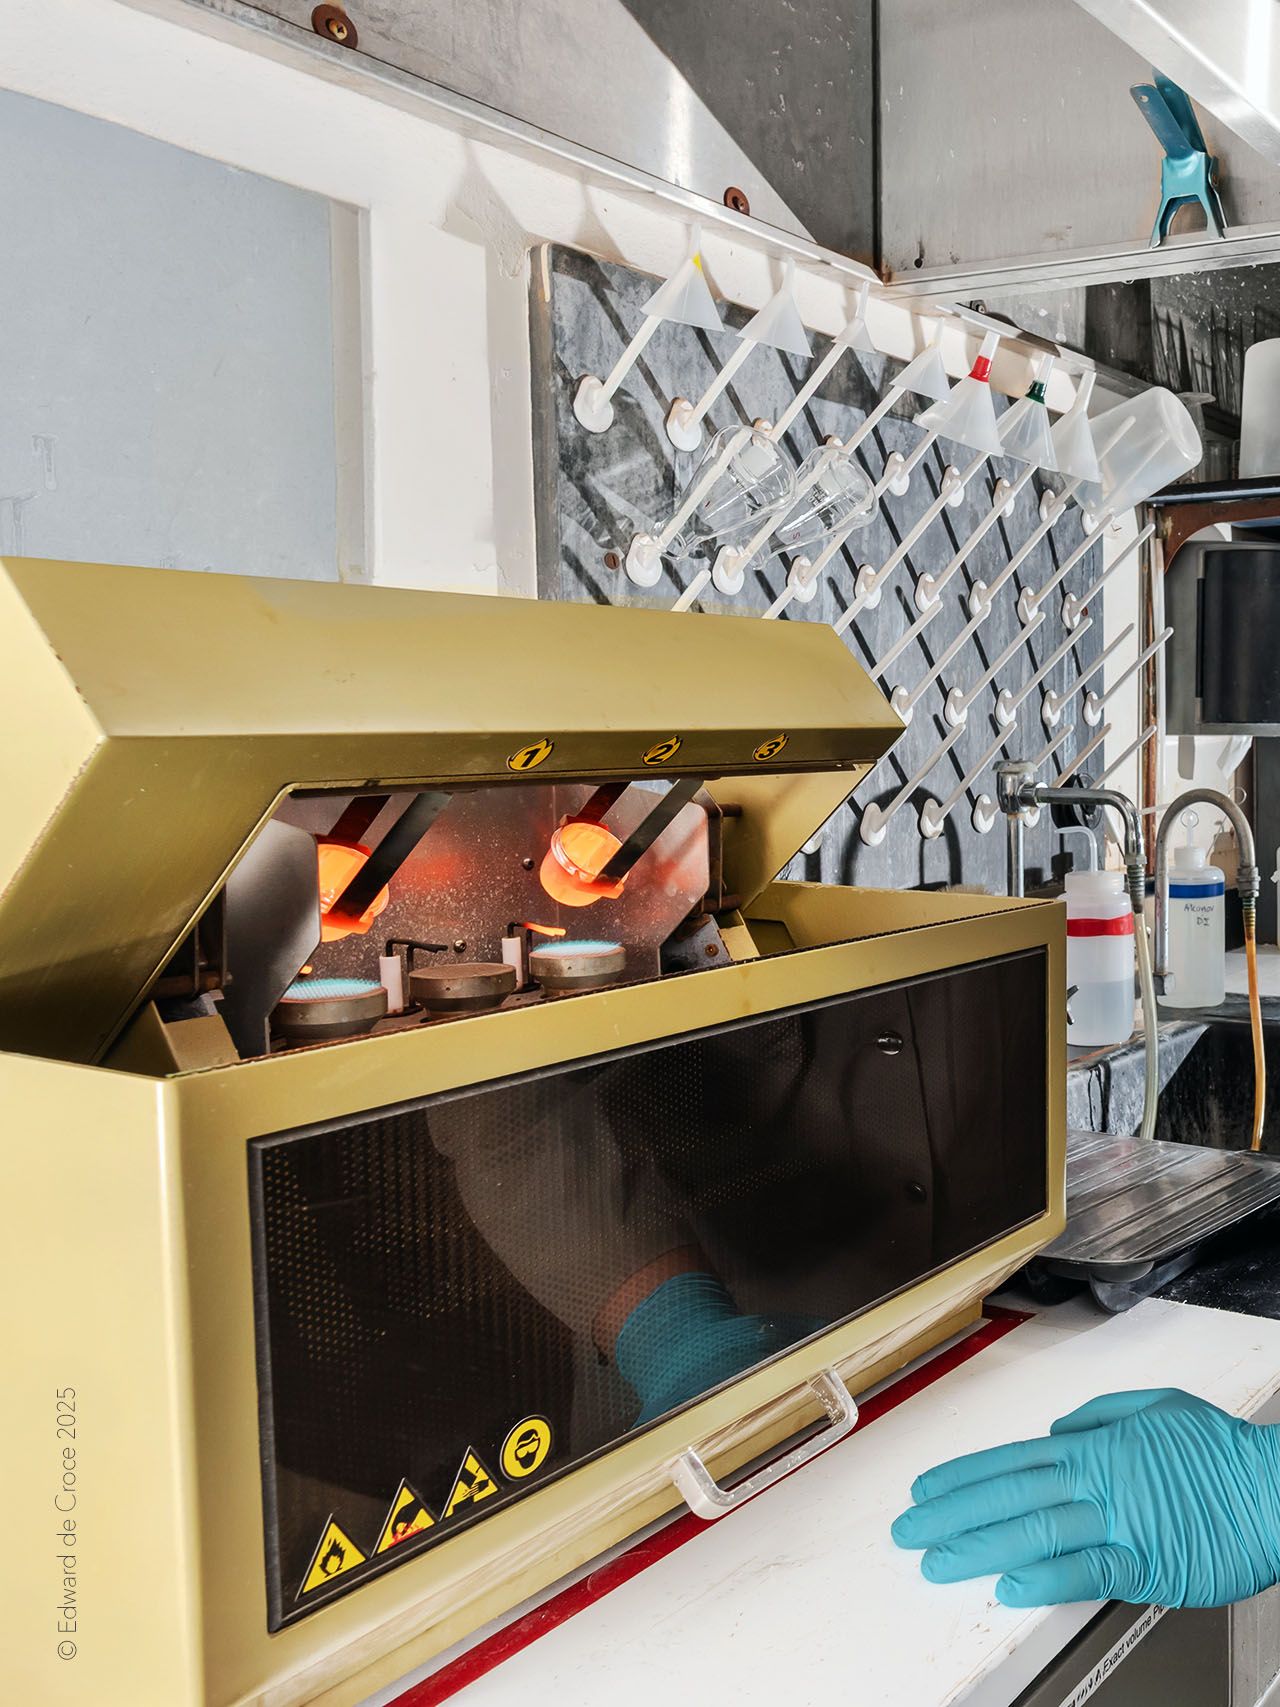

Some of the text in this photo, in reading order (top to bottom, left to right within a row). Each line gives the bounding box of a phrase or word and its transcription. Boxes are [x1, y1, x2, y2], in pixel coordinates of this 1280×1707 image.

[520, 741, 781, 768] 1 2 3
[1103, 1643, 1126, 1675] Exact
[1126, 1616, 1152, 1648] volume
